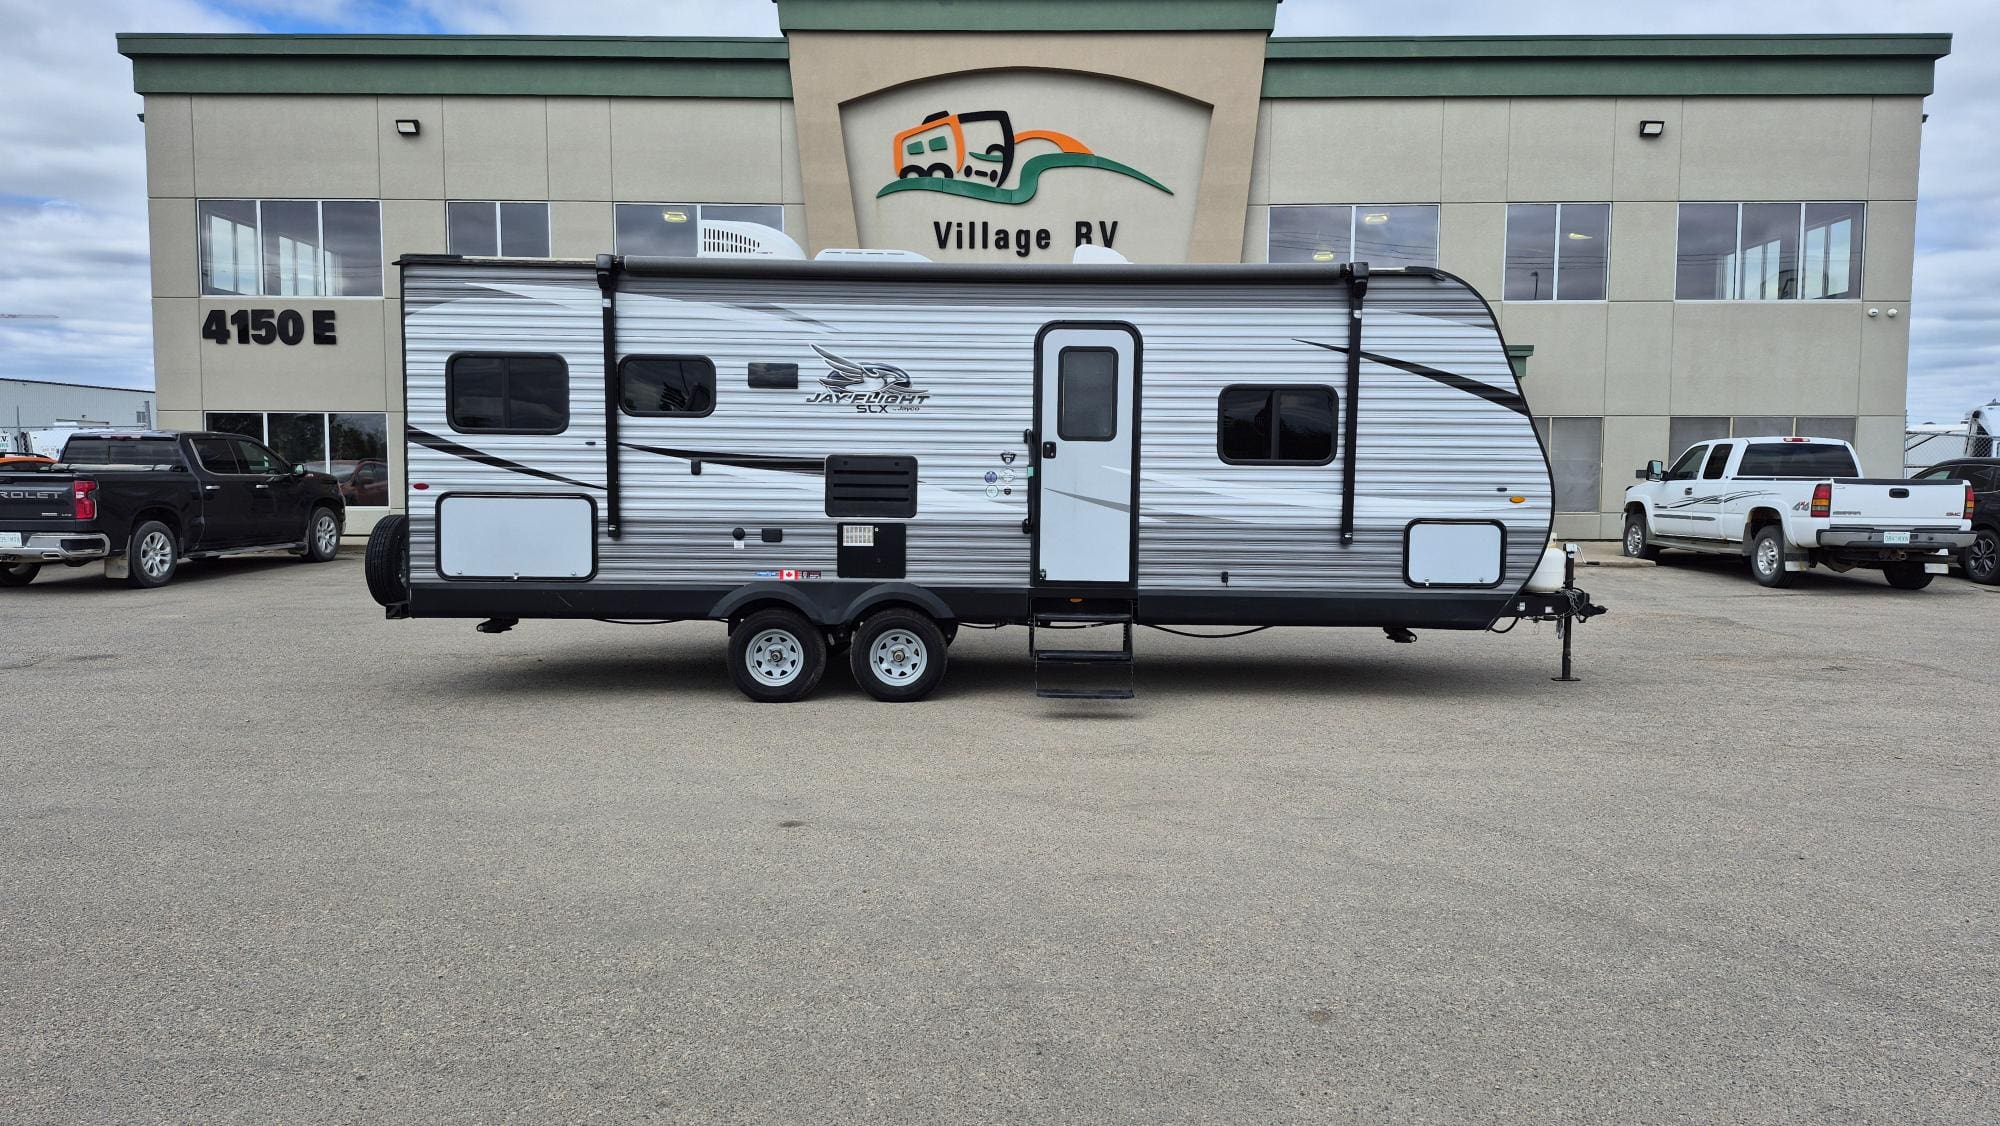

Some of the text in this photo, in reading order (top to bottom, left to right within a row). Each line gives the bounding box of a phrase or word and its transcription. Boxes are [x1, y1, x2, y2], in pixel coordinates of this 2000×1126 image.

[933, 221, 1118, 257] Village RV
[202, 309, 337, 345] 4150 E
[806, 392, 930, 404] JAY FLIGHT
[856, 405, 888, 413] SLX
